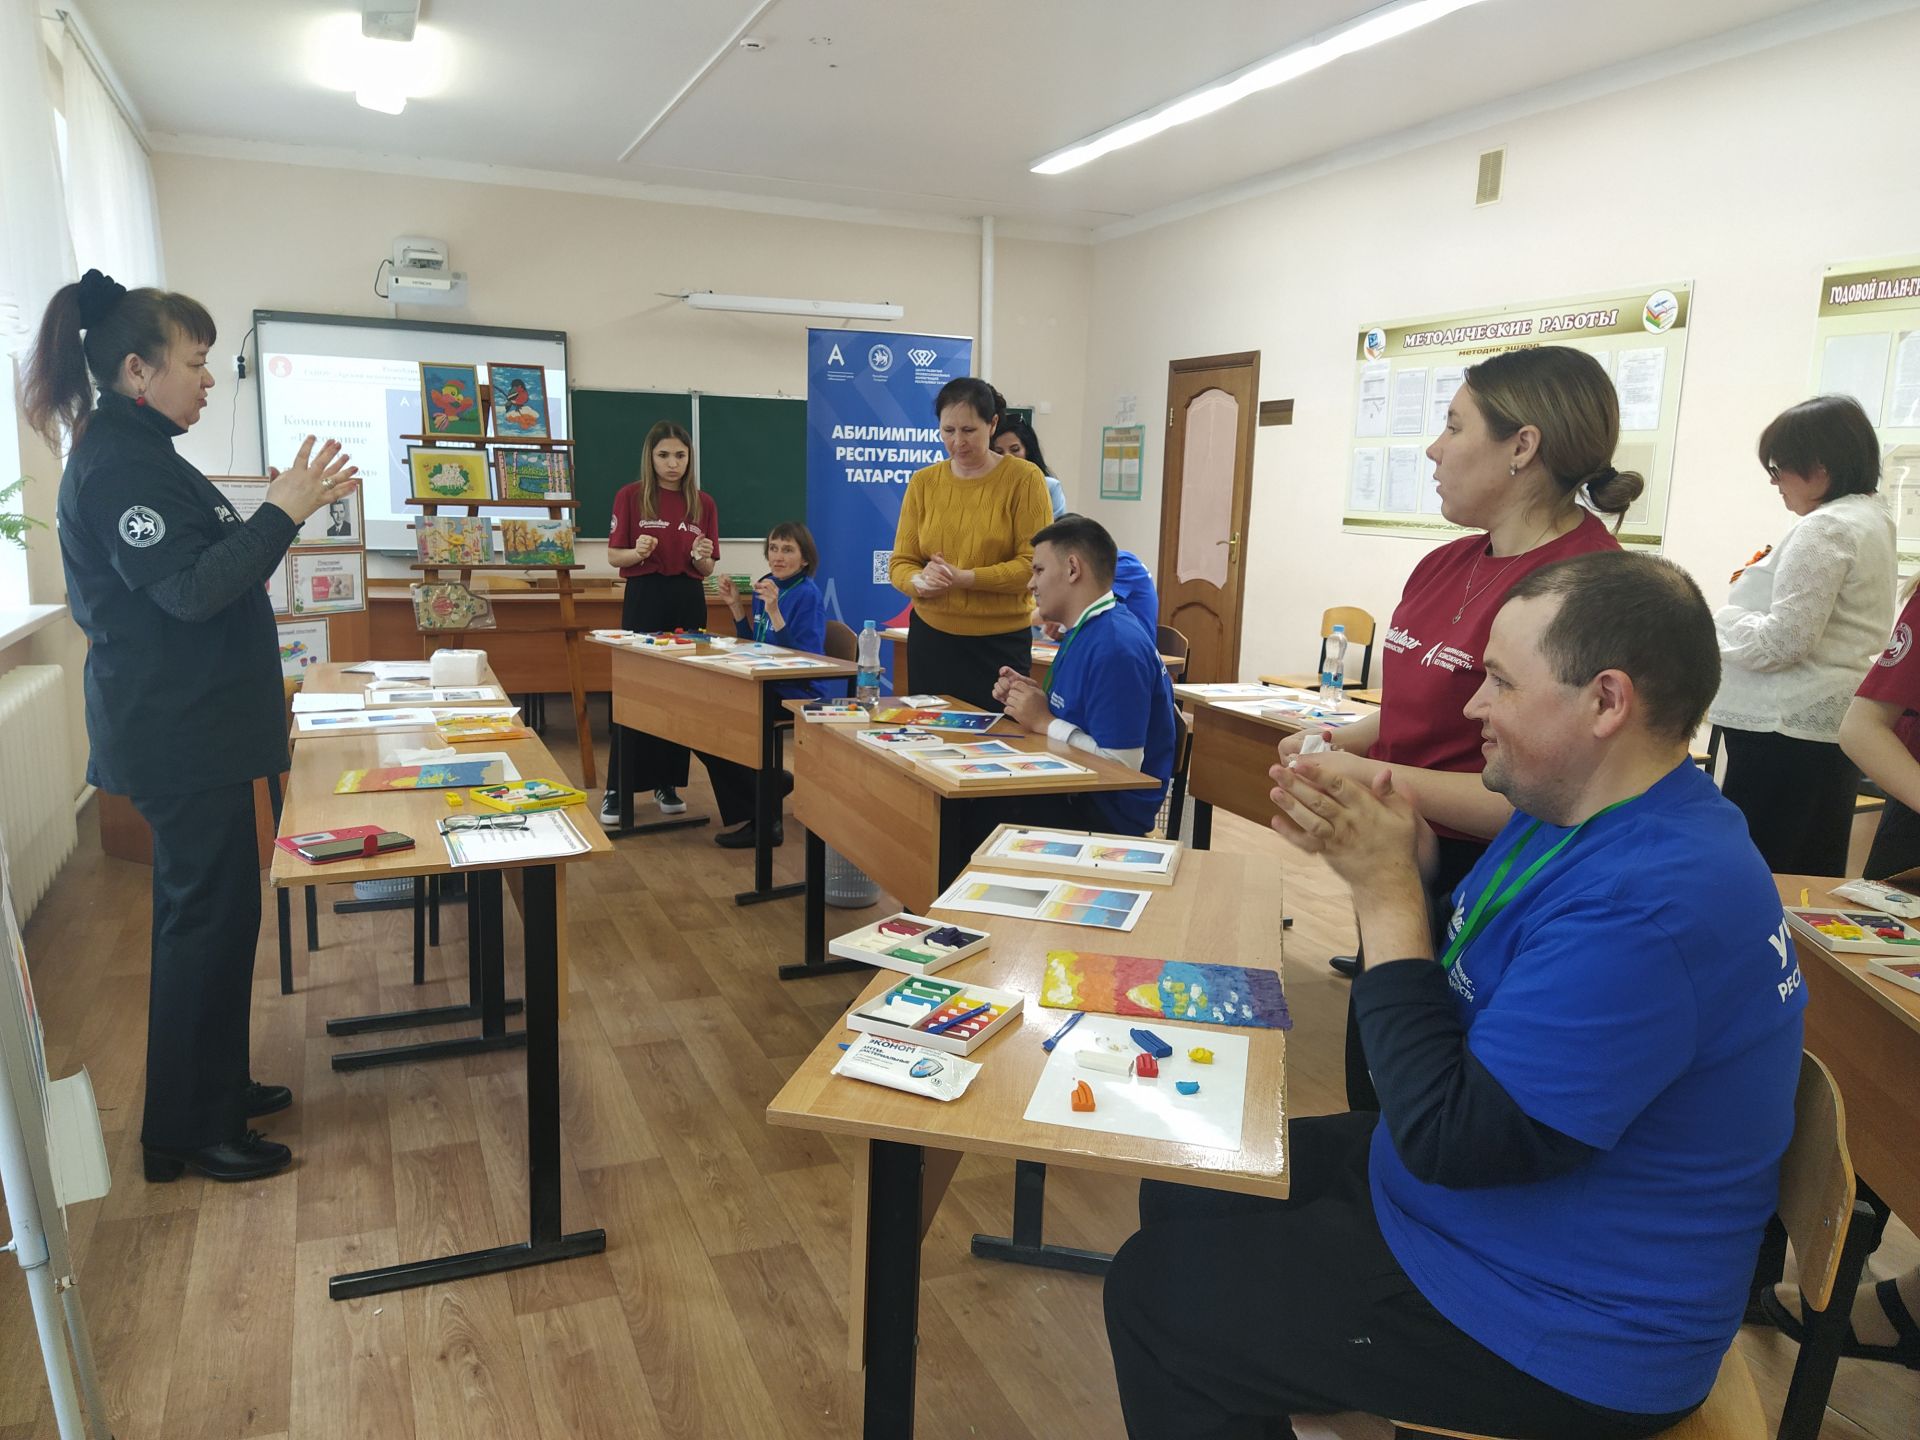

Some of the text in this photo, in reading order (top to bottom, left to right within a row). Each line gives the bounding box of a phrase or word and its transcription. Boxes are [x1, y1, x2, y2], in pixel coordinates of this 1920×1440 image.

[1828, 277, 1877, 306] ГОДОВОЙ
[1403, 309, 1619, 348] МЕТОДИЧЕСКИЕ РАБОТЫ
[1458, 346, 1503, 356] методик
[836, 446, 945, 463] РЕСПУБЛИКА
[845, 468, 918, 483] ТАТАРСТ
